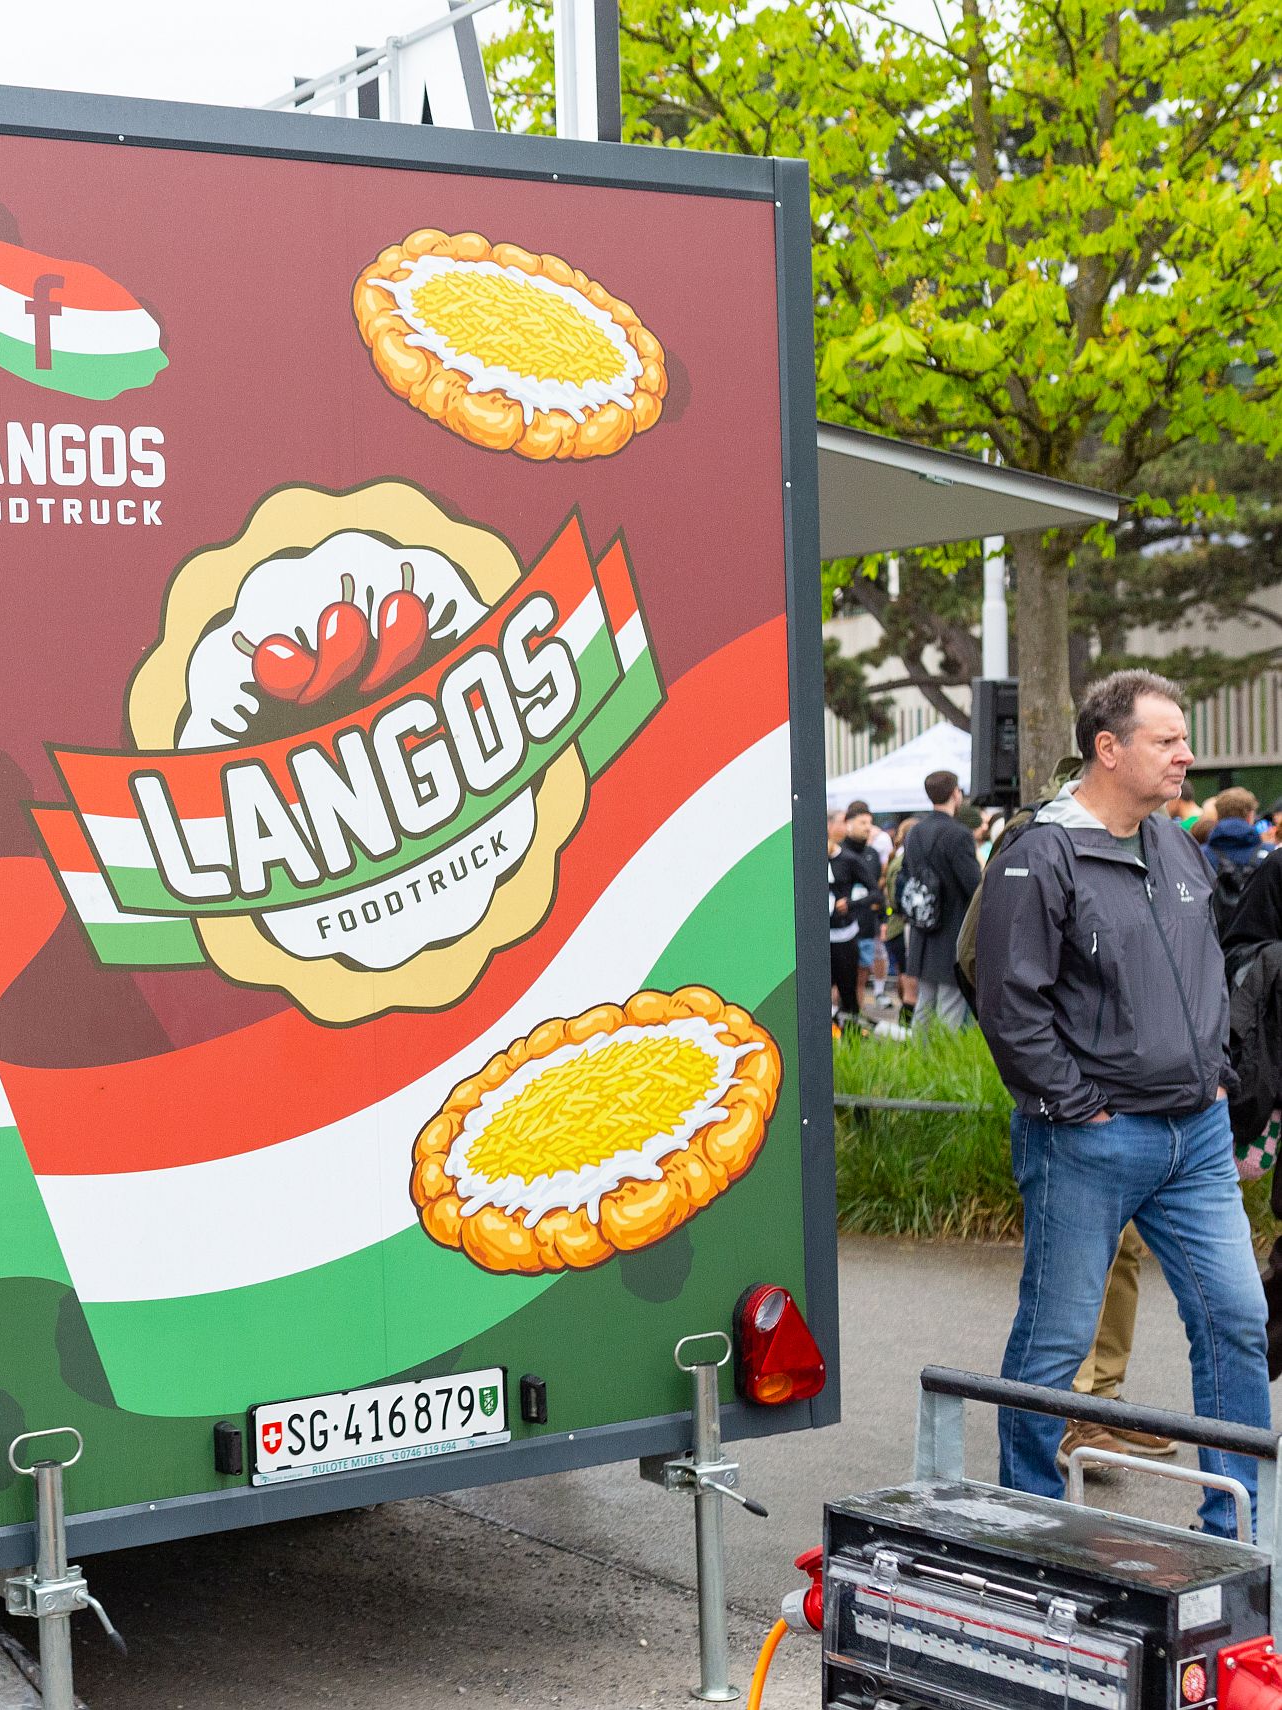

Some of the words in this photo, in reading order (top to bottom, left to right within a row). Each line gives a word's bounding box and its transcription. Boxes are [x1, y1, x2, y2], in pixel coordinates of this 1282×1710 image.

[129, 592, 580, 902] LANGOS
[316, 830, 509, 940] FOODTRUCK
[312, 1460, 349, 1475] RULOTE
[351, 1453, 385, 1468] MURES
[400, 1448, 421, 1460] 0746
[423, 1444, 439, 1456] 119
[441, 1441, 457, 1453] 694
